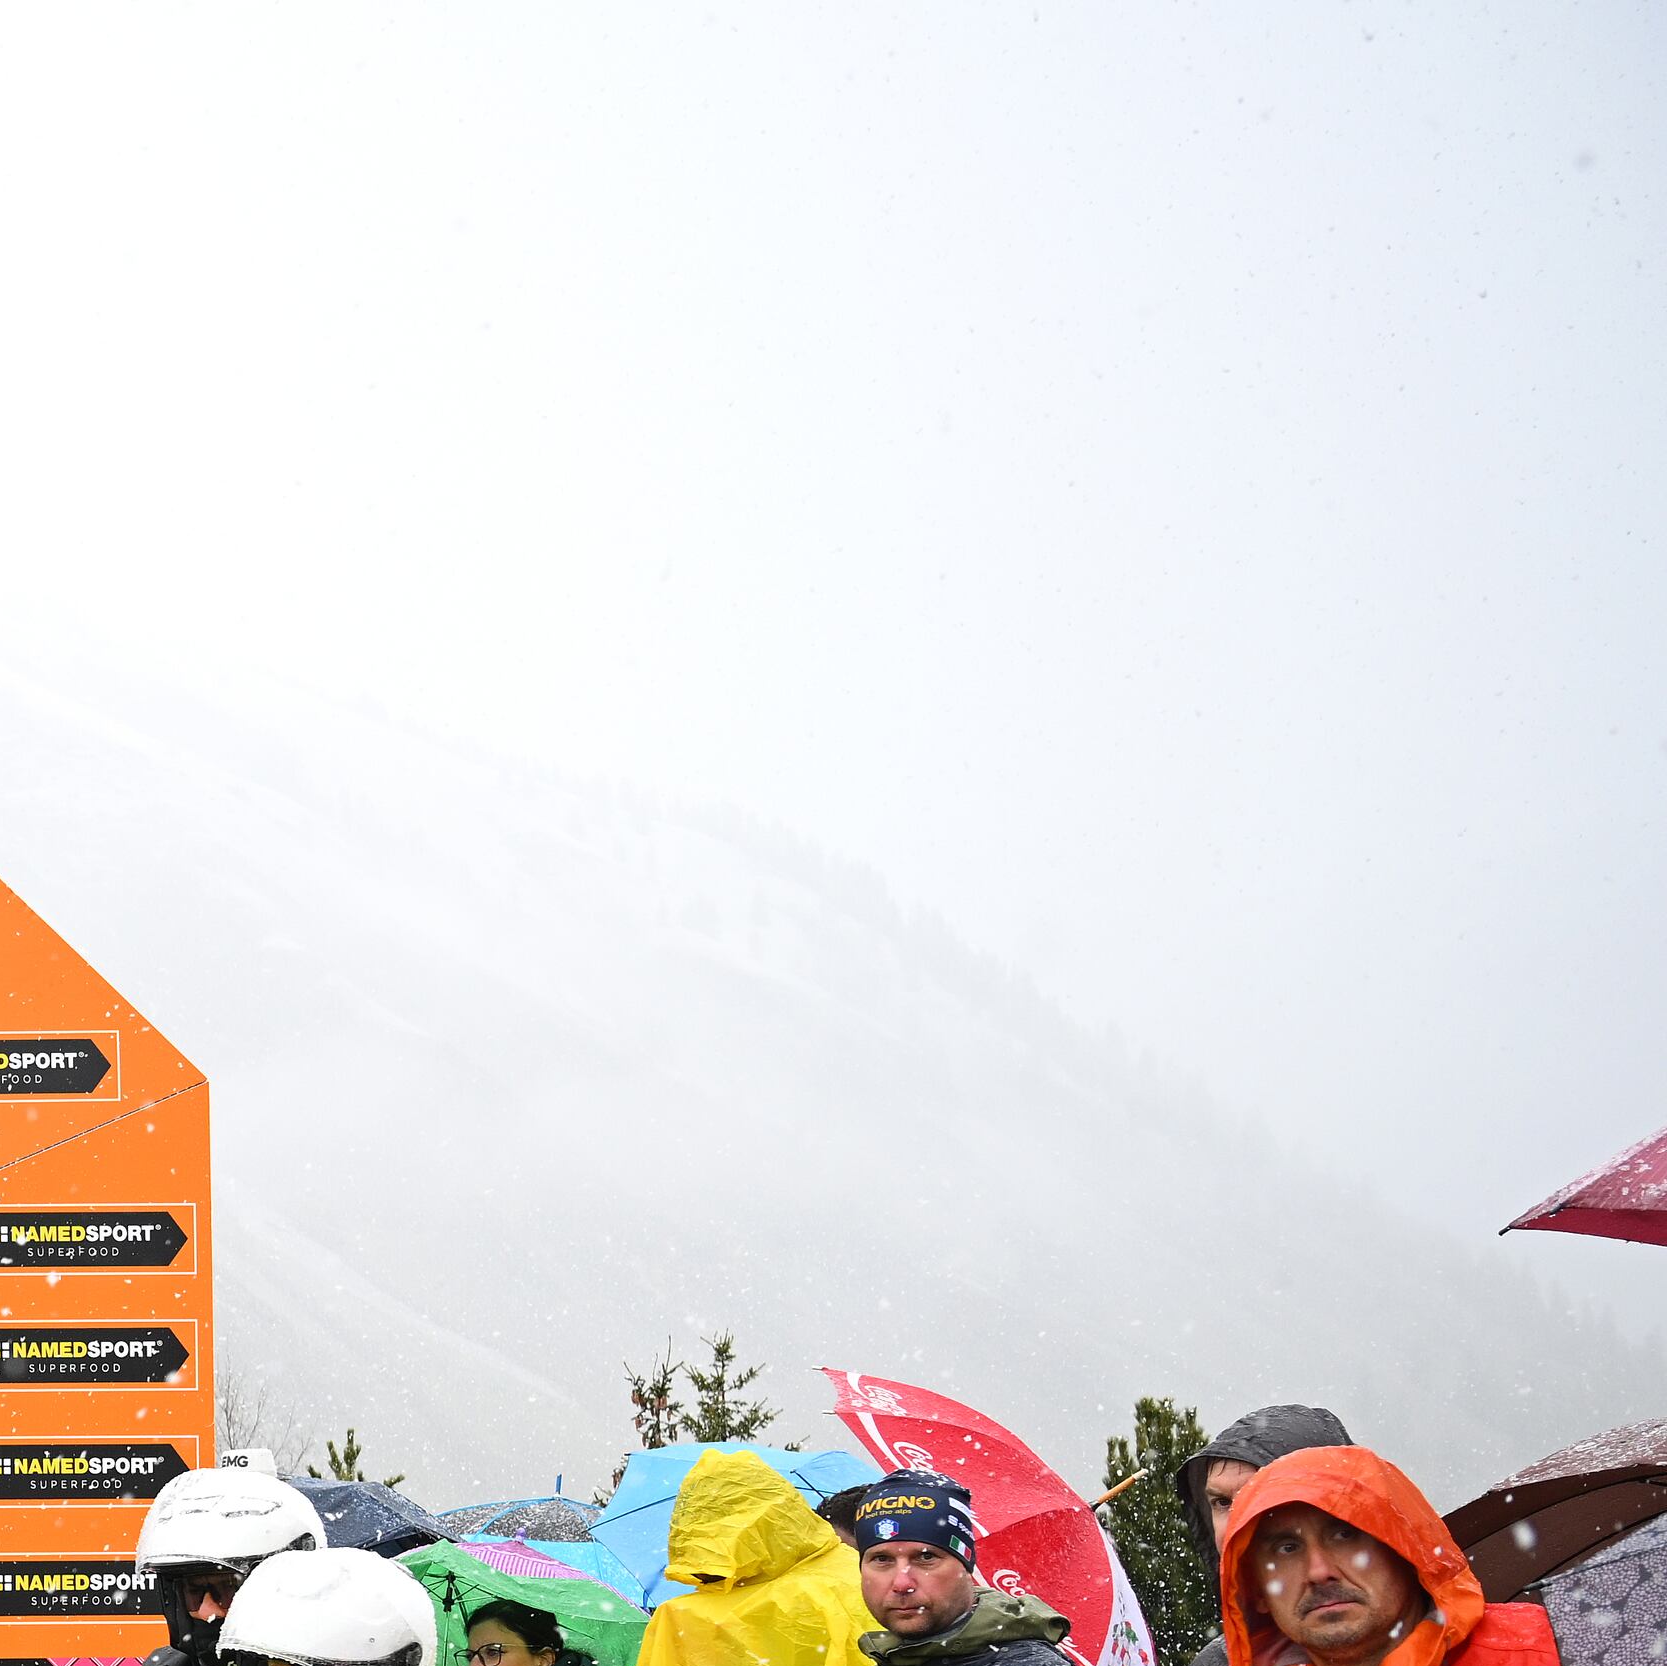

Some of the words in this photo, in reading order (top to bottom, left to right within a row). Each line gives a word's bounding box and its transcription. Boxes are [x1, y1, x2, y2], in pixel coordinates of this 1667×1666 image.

[27, 1247, 120, 1258] SUPERFOOD
[29, 1362, 122, 1374] SUPERFOOD
[30, 1479, 123, 1490] SUPERFOOD
[15, 1573, 158, 1592] NAMEDSPORT
[31, 1596, 124, 1606] SUPERFOOD
